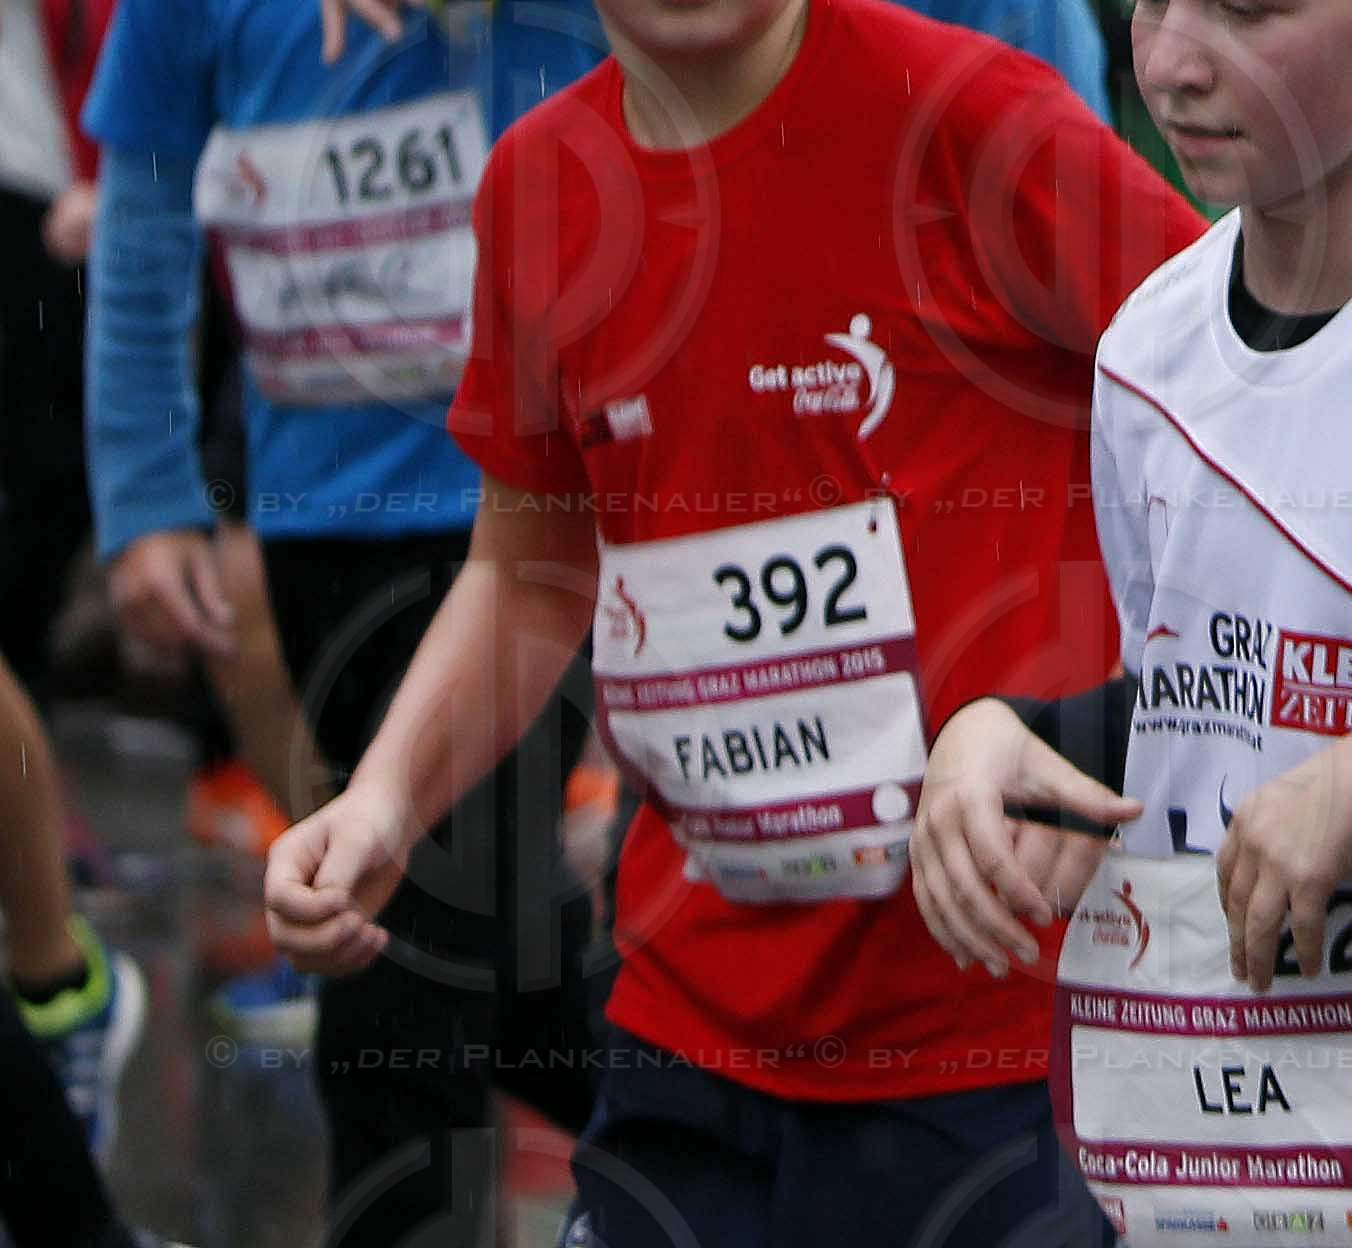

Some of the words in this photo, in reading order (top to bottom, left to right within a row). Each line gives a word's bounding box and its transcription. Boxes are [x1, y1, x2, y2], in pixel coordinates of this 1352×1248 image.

[321, 123, 463, 202] 1261
[713, 544, 868, 644] 392
[1208, 610, 1272, 670] GRA
[673, 715, 831, 783] FABIAN
[1070, 992, 1116, 1021] KLEINE
[1119, 999, 1186, 1027] ZEITUNG
[1191, 1005, 1239, 1031] GRAZ
[1242, 1002, 1352, 1031] MARATHON
[1192, 1065, 1292, 1116] LEA
[1077, 1147, 1170, 1181] Coca-Cola
[1175, 1150, 1241, 1181] Junior
[1246, 1153, 1344, 1183] Marathon
